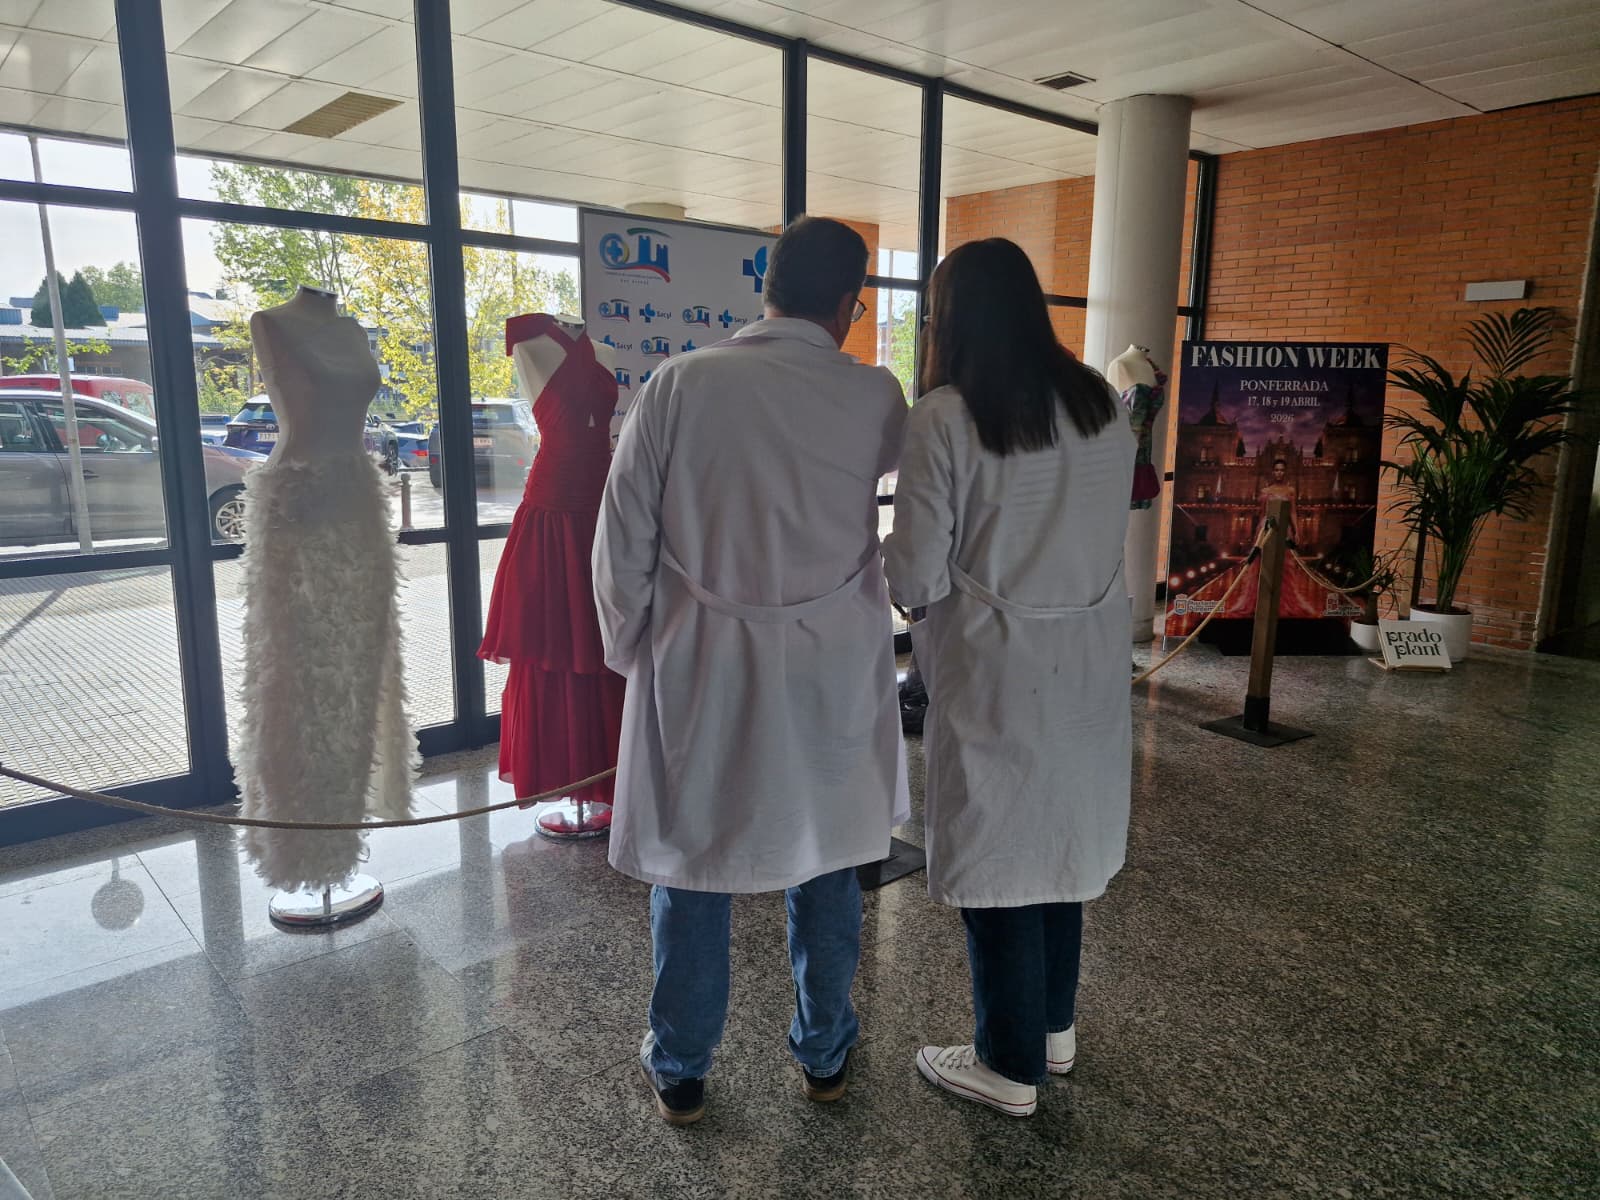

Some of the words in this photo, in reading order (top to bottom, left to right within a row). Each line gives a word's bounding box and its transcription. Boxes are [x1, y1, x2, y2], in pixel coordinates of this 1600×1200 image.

[1191, 345, 1299, 368] FASHION
[1307, 347, 1381, 369] WEEK
[1240, 379, 1328, 392] PONFERRADA
[1262, 396, 1271, 407] 18
[1291, 396, 1320, 407] ABRIL
[1270, 413, 1294, 424] 2026
[1385, 628, 1442, 646] prado
[1394, 641, 1441, 659] plant
